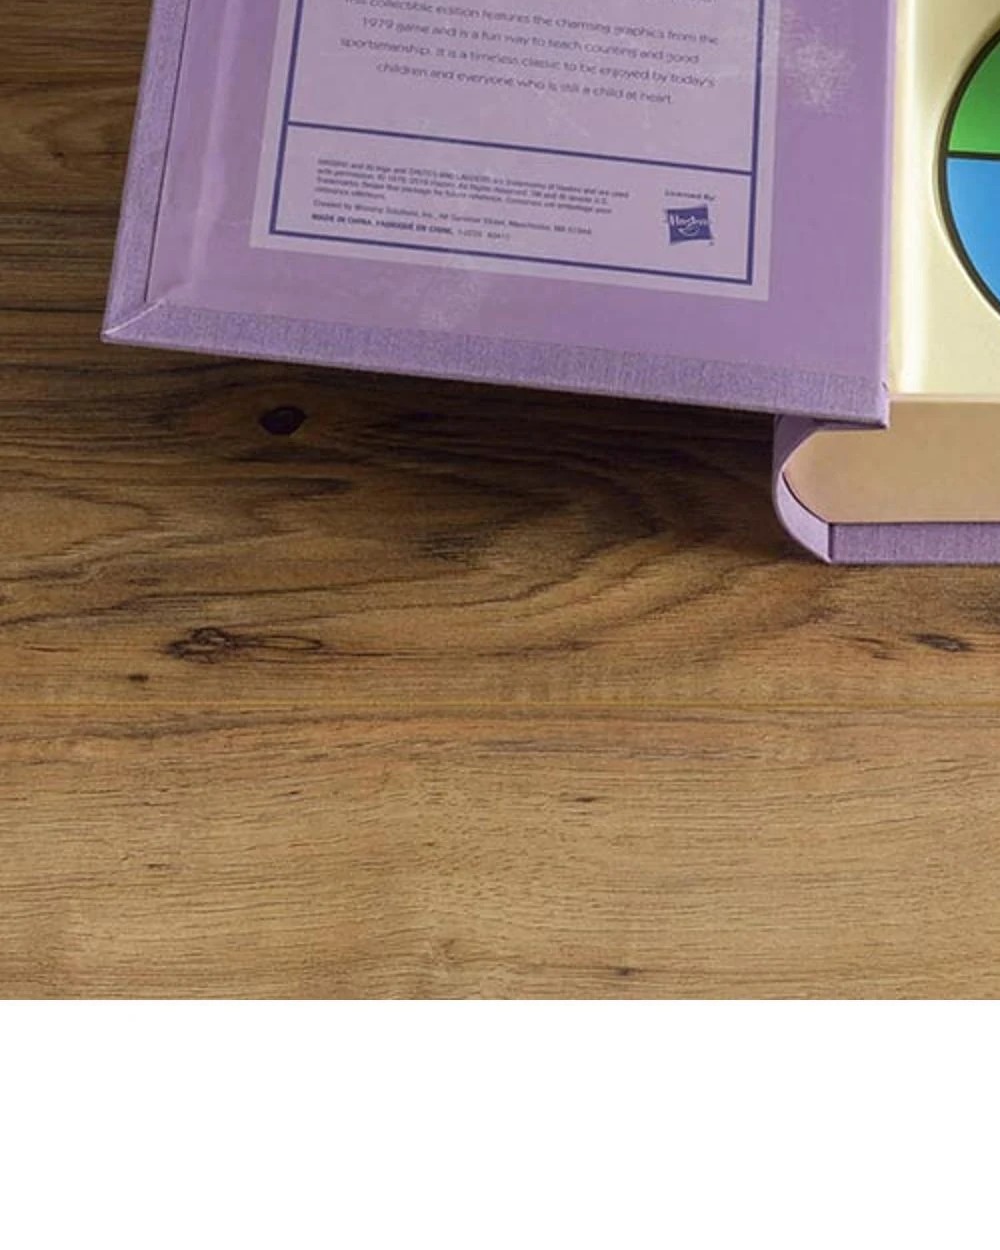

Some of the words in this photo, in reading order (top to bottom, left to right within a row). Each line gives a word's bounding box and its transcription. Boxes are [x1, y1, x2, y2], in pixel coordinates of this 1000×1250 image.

[361, 16, 394, 29] 1979
[395, 23, 430, 36] game
[430, 24, 457, 36] and
[458, 27, 468, 38] is
[480, 30, 501, 41] fun
[532, 35, 546, 46] to
[582, 41, 638, 59] counting
[638, 47, 664, 60] and
[665, 50, 699, 66] good
[532, 15, 552, 26] the
[554, 17, 610, 35] charming
[666, 30, 696, 42] from
[698, 34, 719, 45] the
[429, 67, 454, 79] and
[456, 73, 513, 88] everyone
[516, 77, 545, 89] who
[547, 81, 557, 91] is
[592, 86, 622, 98] child
[562, 60, 577, 71] to
[598, 64, 648, 82] enjoyed
[652, 70, 666, 84] by
